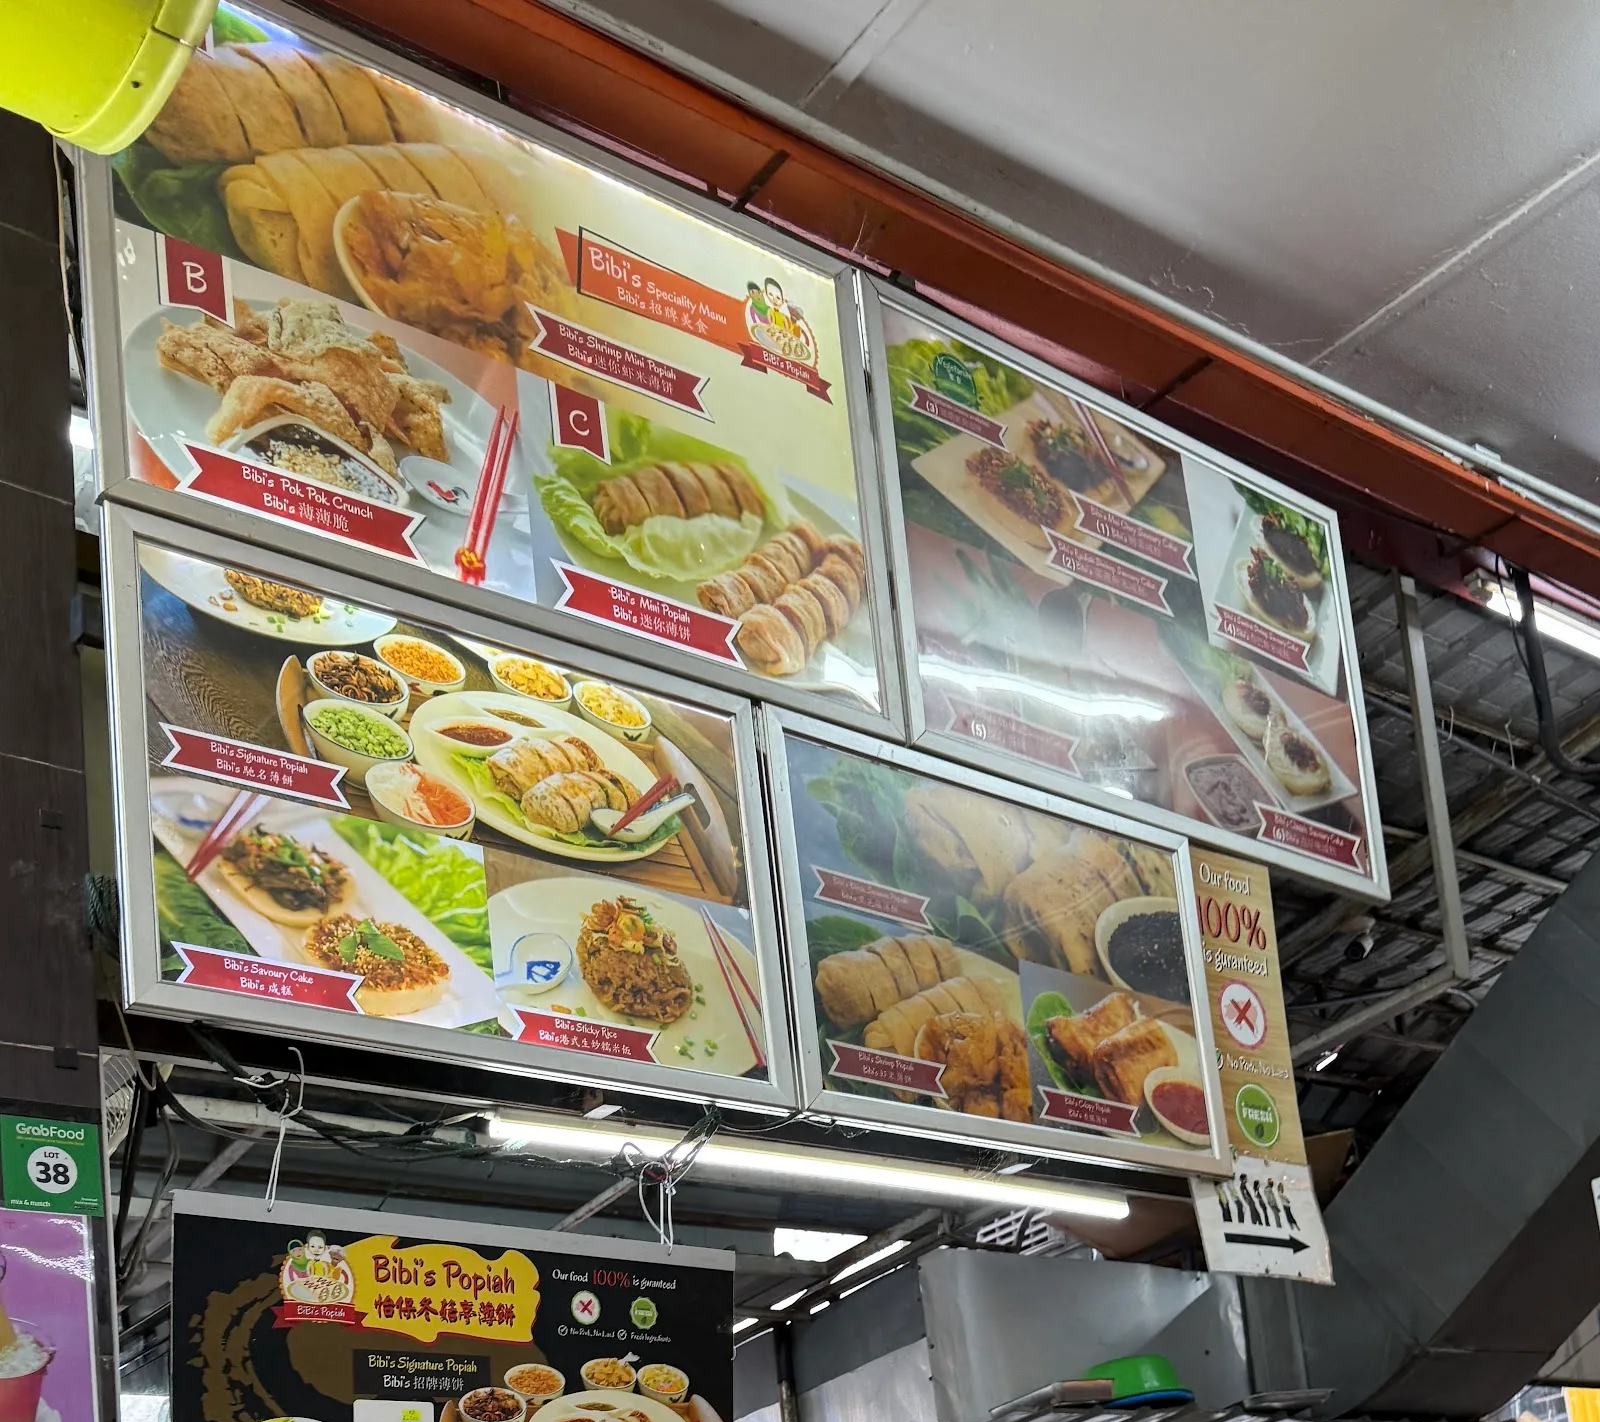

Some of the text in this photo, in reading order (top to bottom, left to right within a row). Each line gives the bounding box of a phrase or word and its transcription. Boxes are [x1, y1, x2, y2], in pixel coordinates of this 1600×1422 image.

[181, 261, 208, 293] B
[588, 246, 727, 326] Bibi's Speciality Menu
[616, 286, 646, 310] Bibi's
[558, 323, 678, 381] Bibi's Shrimp Mini Popiah
[567, 344, 593, 365] Bibi's
[568, 409, 591, 437] C
[241, 465, 374, 520] Bibi's Pok Pok Crunch
[263, 493, 296, 515] Bibi's
[1096, 519, 1110, 537] (1)
[1062, 553, 1077, 571] (2)
[611, 585, 691, 625] Bibi's Mini Popiah
[613, 604, 639, 625] Bibi's
[971, 720, 987, 740] (5)
[210, 741, 309, 775] Bibi's Signature Popiah
[215, 758, 241, 774] Bibi's
[1199, 862, 1251, 896] Our food
[223, 958, 314, 985] Bibi's Savoury Cake
[239, 977, 265, 991] Bibi's
[538, 1029, 560, 1043] Bibi's
[555, 1018, 618, 1040] Bibi's Sticky Rice
[16, 1122, 84, 1140] GrabFood
[43, 1151, 60, 1159] LOT
[35, 1161, 70, 1185] 38
[372, 1254, 516, 1301] Bibi's Popiah
[552, 1268, 569, 1281] Our
[569, 1271, 589, 1283] food
[591, 1268, 631, 1288] 100%
[320, 1306, 346, 1319] Popiah
[368, 1354, 478, 1376] Bibi's Signature Popiah
[383, 1374, 411, 1388] Bibi's
